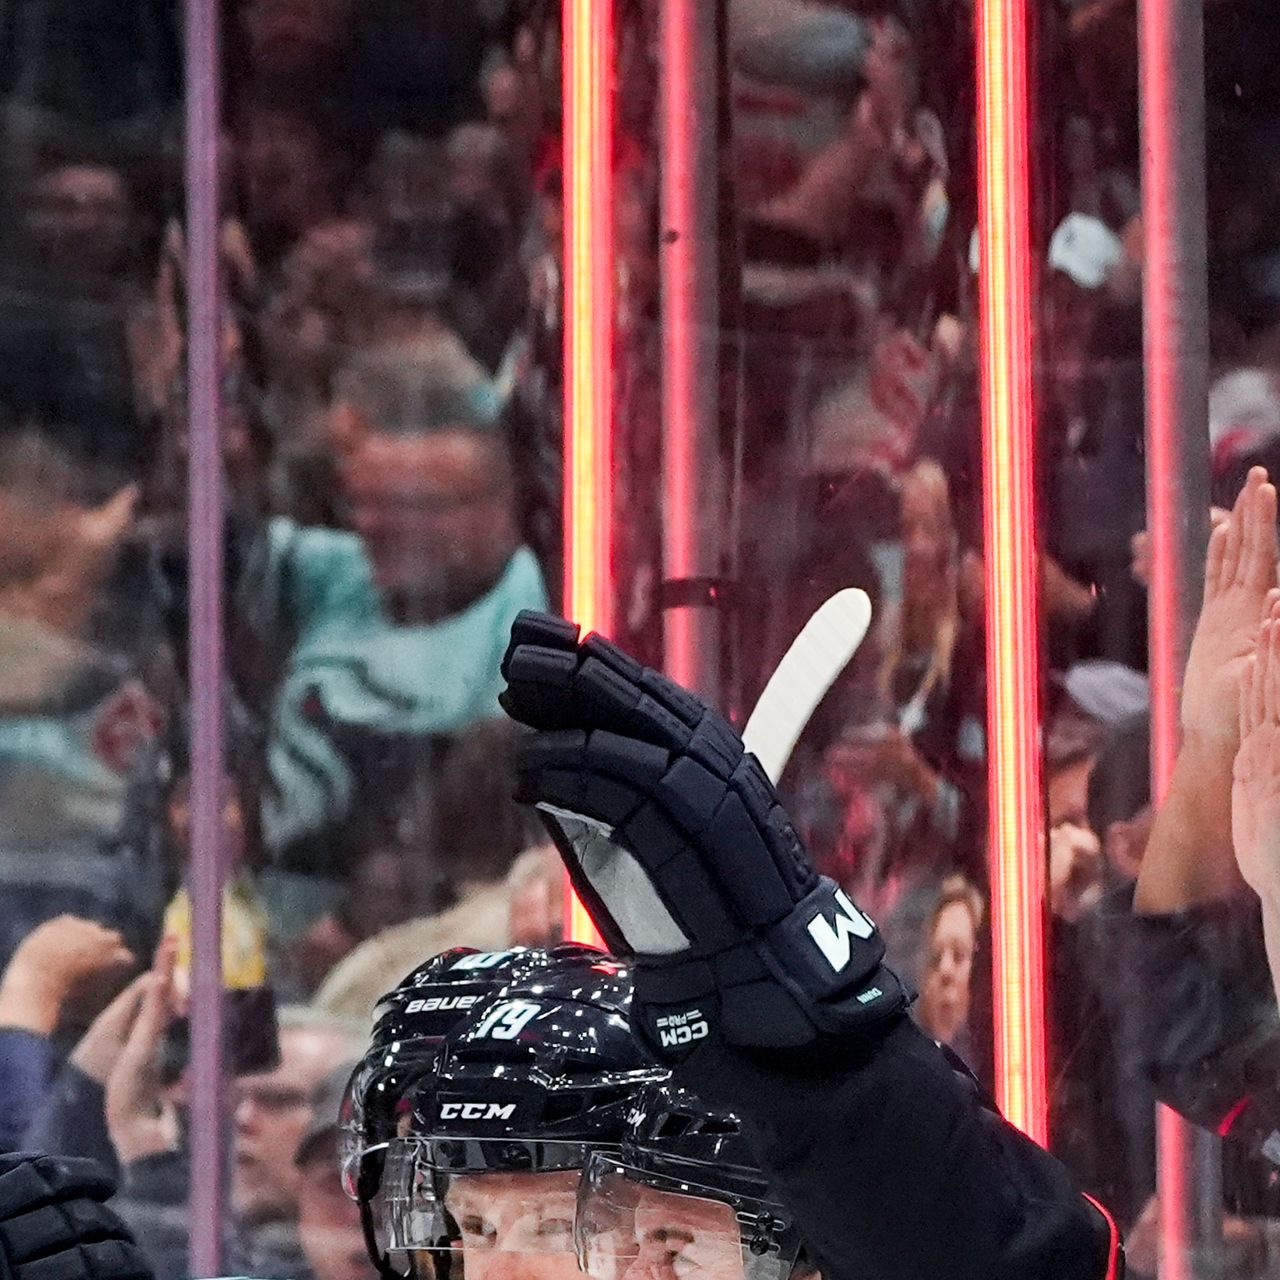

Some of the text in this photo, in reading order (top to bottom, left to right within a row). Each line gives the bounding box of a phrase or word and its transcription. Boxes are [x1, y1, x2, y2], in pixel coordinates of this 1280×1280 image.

[475, 1001, 541, 1040] 19
[660, 1021, 709, 1047] CCM
[440, 1103, 516, 1120] CCM
